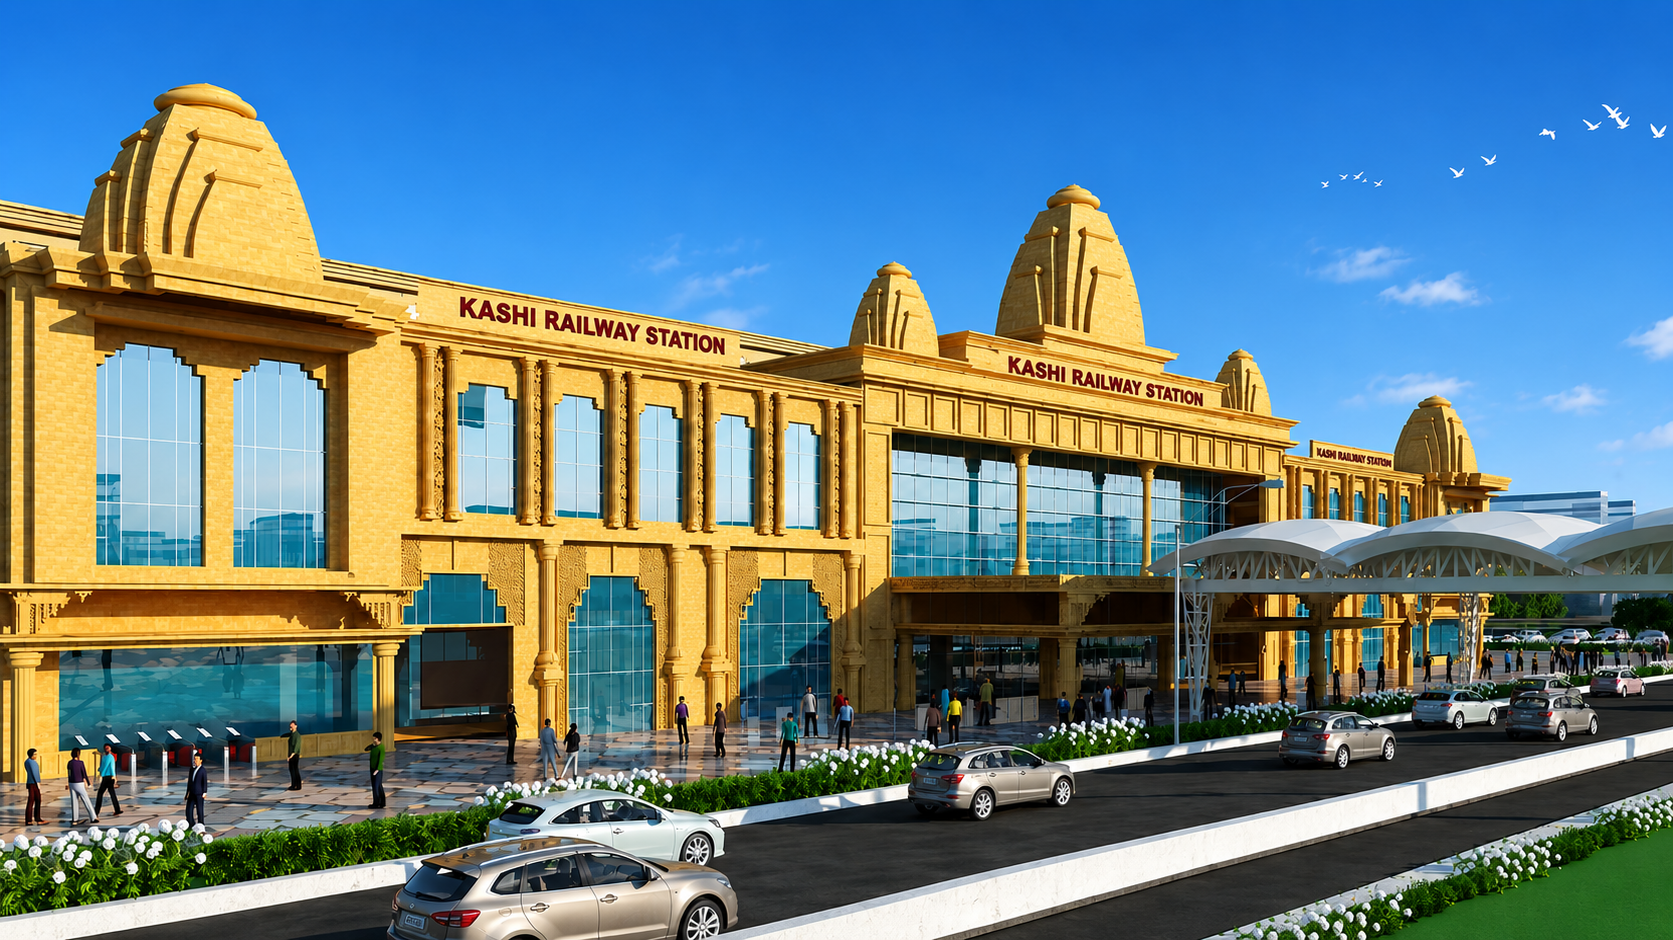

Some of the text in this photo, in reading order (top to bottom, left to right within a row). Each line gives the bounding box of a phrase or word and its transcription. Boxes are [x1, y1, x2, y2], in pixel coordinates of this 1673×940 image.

[459, 296, 726, 356] KASHI RAILWAY STATION
[1008, 355, 1204, 407] KASHI RAILWAY STATION
[1316, 447, 1392, 468] KASHI RAILWAY STATION
